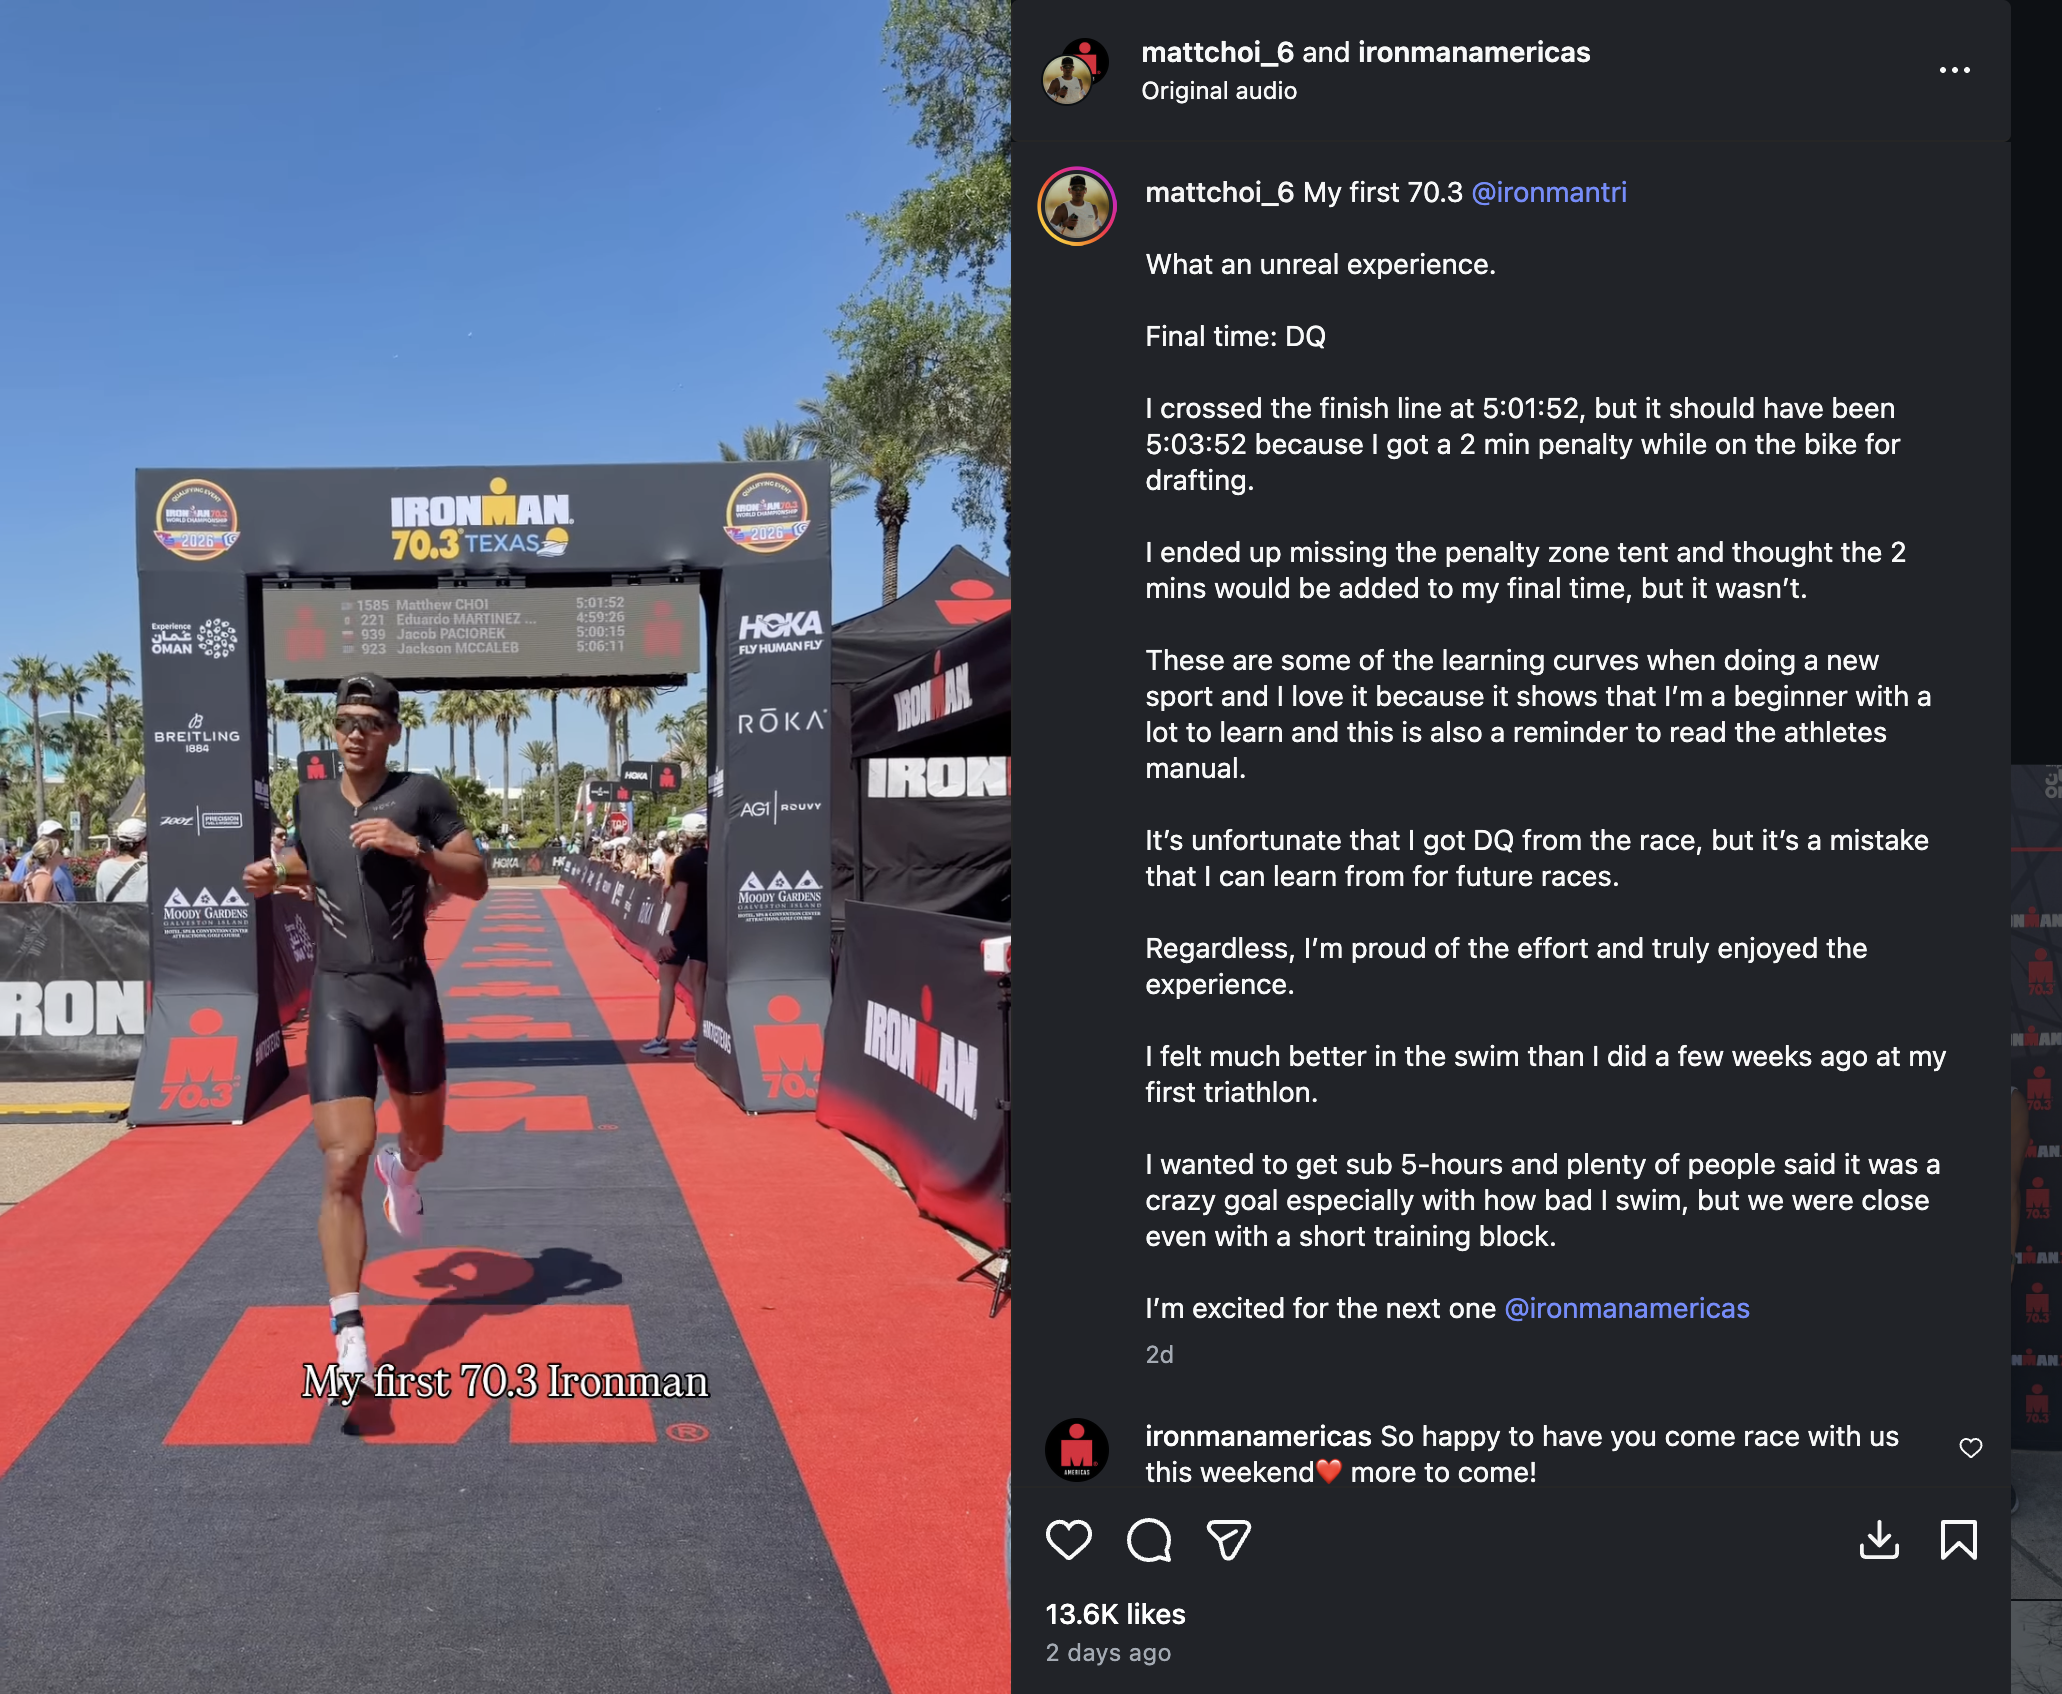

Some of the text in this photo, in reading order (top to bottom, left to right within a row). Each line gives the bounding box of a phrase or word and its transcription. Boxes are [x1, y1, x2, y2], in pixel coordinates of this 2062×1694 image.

[172, 487, 221, 502] QUALIFYING EVENT
[742, 480, 792, 497] QUALIFYING EVENT
[391, 492, 570, 527] IRONMAN
[780, 501, 798, 509] 70.3
[211, 510, 228, 518] 70.3
[756, 509, 798, 517] CHAMPIONSHIP
[751, 526, 783, 540] 2026
[181, 534, 214, 548] 2026
[391, 528, 539, 560] 70.3 TEXAS
[357, 596, 625, 611] 1585 Matthew CHOI 5:01:52
[361, 614, 384, 626] 221
[397, 613, 450, 625] Eduardo
[454, 613, 521, 624] MARTINEZ
[576, 611, 625, 623] 4:59:26
[739, 610, 823, 640] HOKA
[152, 623, 191, 631] Experience
[361, 626, 625, 640] 939 Jacob PACIOREK 5:00:15
[151, 644, 192, 654] OMAN
[361, 640, 624, 654] 923 Jackson MCCALEB 5:06:11
[739, 640, 822, 655] FLY HUMAN FLY
[894, 657, 971, 732] IRONMAN
[154, 731, 240, 742] BREITLING
[186, 744, 209, 753] 1884
[625, 771, 648, 780] HOKA
[740, 802, 821, 817] AG1 ROUVY
[492, 857, 519, 869] HOKA
[738, 890, 821, 903] MOODY GARDENS
[164, 907, 248, 920] MOODY GARDENS
[864, 995, 978, 1118] IRONMAN
[158, 1084, 232, 1110] 70.3
